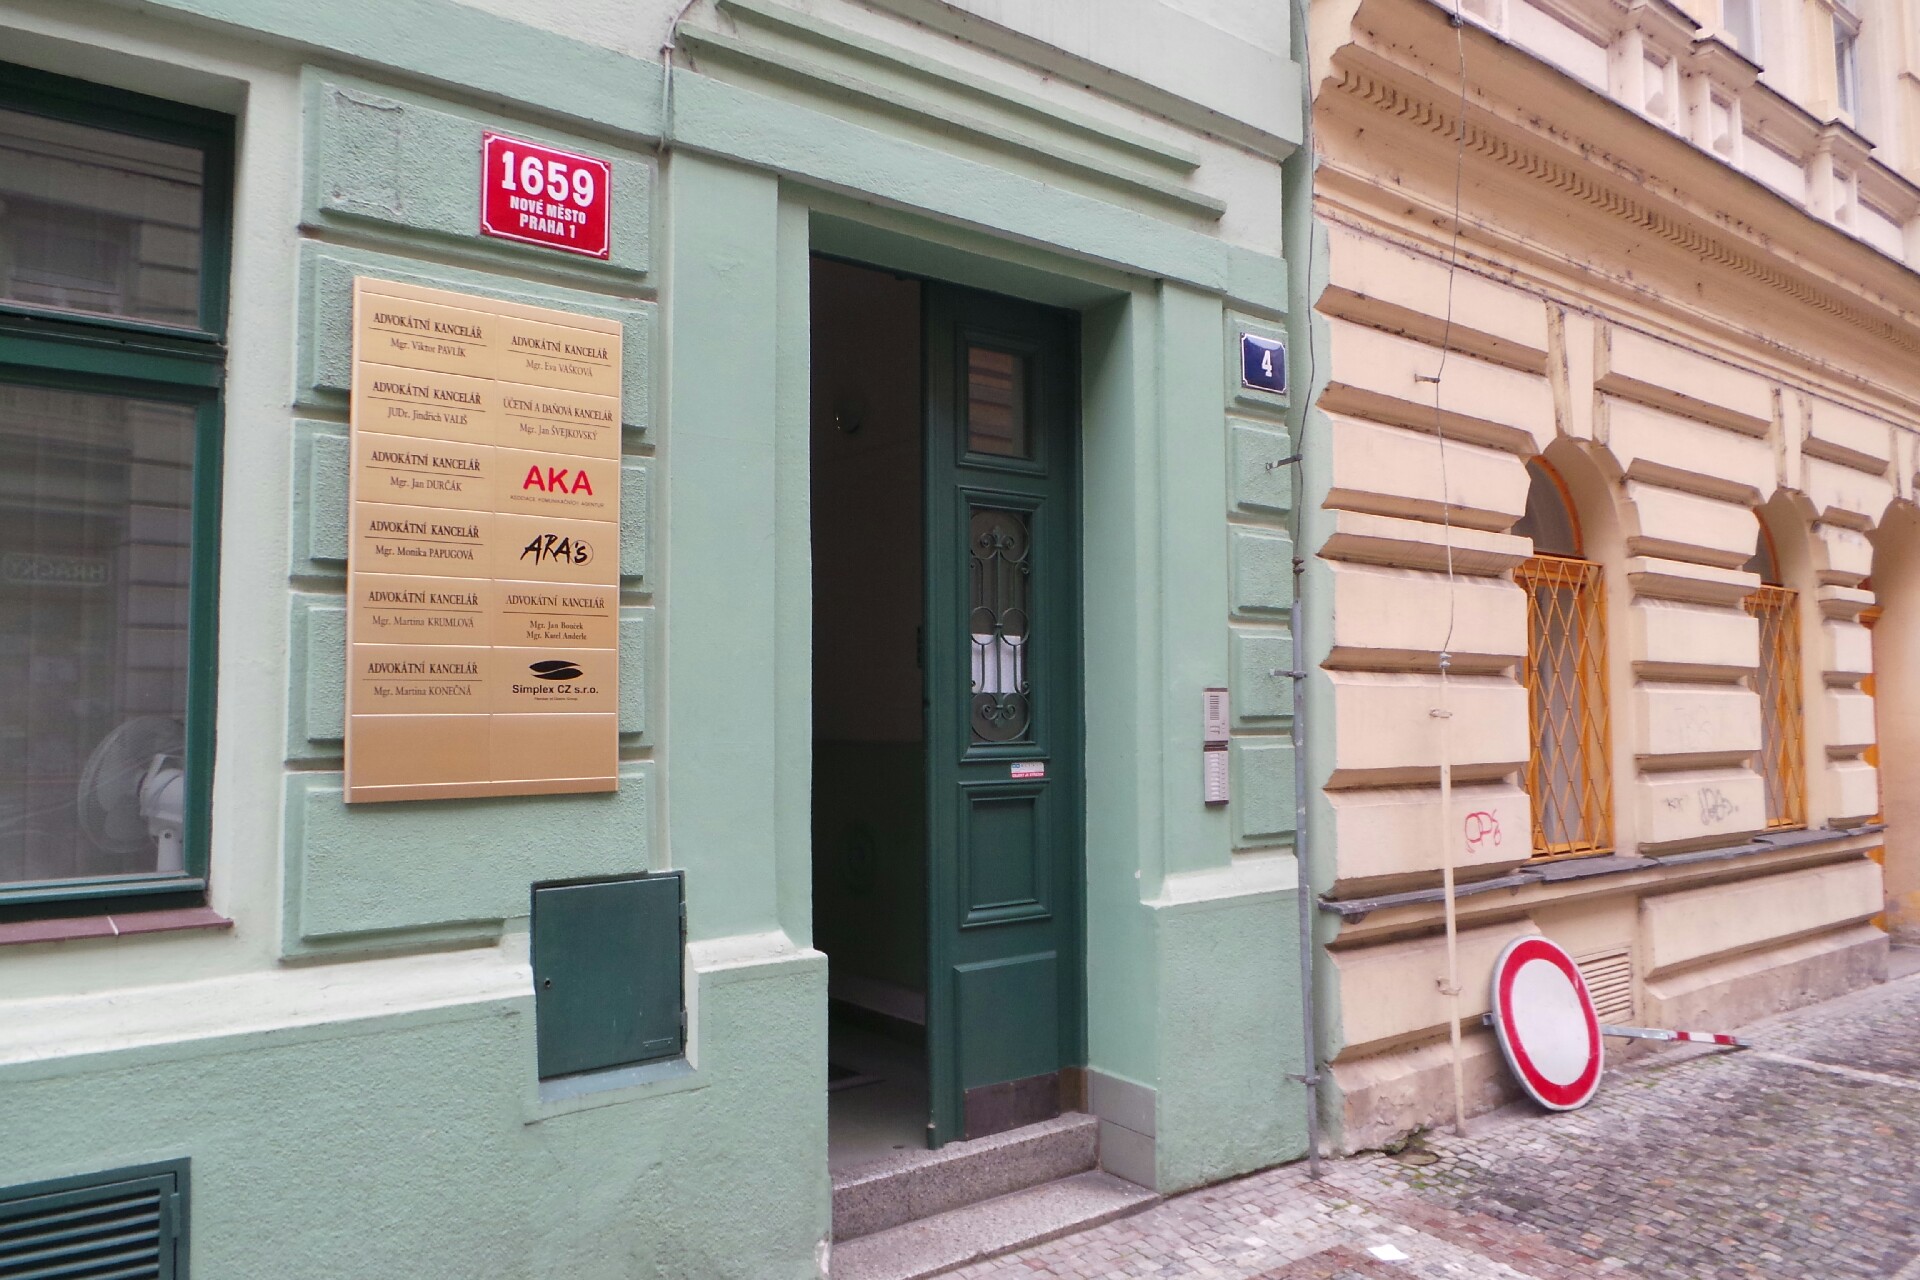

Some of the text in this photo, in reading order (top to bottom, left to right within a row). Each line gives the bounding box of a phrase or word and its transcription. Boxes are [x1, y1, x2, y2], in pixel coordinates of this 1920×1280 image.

[502, 151, 594, 207] 1659
[510, 196, 586, 224] NOVÉ MĚSTO
[519, 214, 576, 238] PRAHA 1
[374, 313, 482, 338] ADVOKÁTNÍ KANCELÁŘ
[391, 338, 465, 357] Mgr. Viktor PAVLÍK
[512, 336, 608, 360] ADVOKÁTNÍ KANCELÁŘ
[526, 360, 593, 376] Mgr. Eva VAŠKOVÁ
[1262, 350, 1272, 377] 4
[373, 381, 481, 404] ADVOKÁTNÍ KANCELÁŘ
[388, 407, 410, 418] JUDr.
[412, 410, 441, 422] Jindřich
[503, 395, 612, 421] ÚČETNÍ A DAŇOVÁ KANCELÁŘ
[520, 423, 597, 440] Mgr. Jan ŠVEJKOVSKÝ
[371, 451, 480, 471] ADVOKÁTNÍ KANCELÁŘ
[391, 477, 462, 491] Mgr. Jan DURČÁK
[523, 465, 593, 496] AKA
[370, 520, 479, 538] ADVOKÁTNÍ KANCELÁŘ
[376, 545, 473, 560] Mgr. Monika PAPUGOVÁ
[369, 590, 478, 605] ADVOKÁTNÍ KANCELÁŘ
[506, 594, 604, 608] ADVOKÁTNÍ KANCELÁŘ
[373, 616, 474, 628] Mgr. Martina KRUMLOVÁ
[530, 621, 545, 630] Mgr.
[527, 631, 542, 640] Mgr.
[368, 661, 477, 674] ADVOKÁTNÍ KANCELÁŘ
[374, 685, 471, 698] Mgr. Martina KONEČNÁ
[513, 685, 598, 695] Simplex CZ s.r.o.
